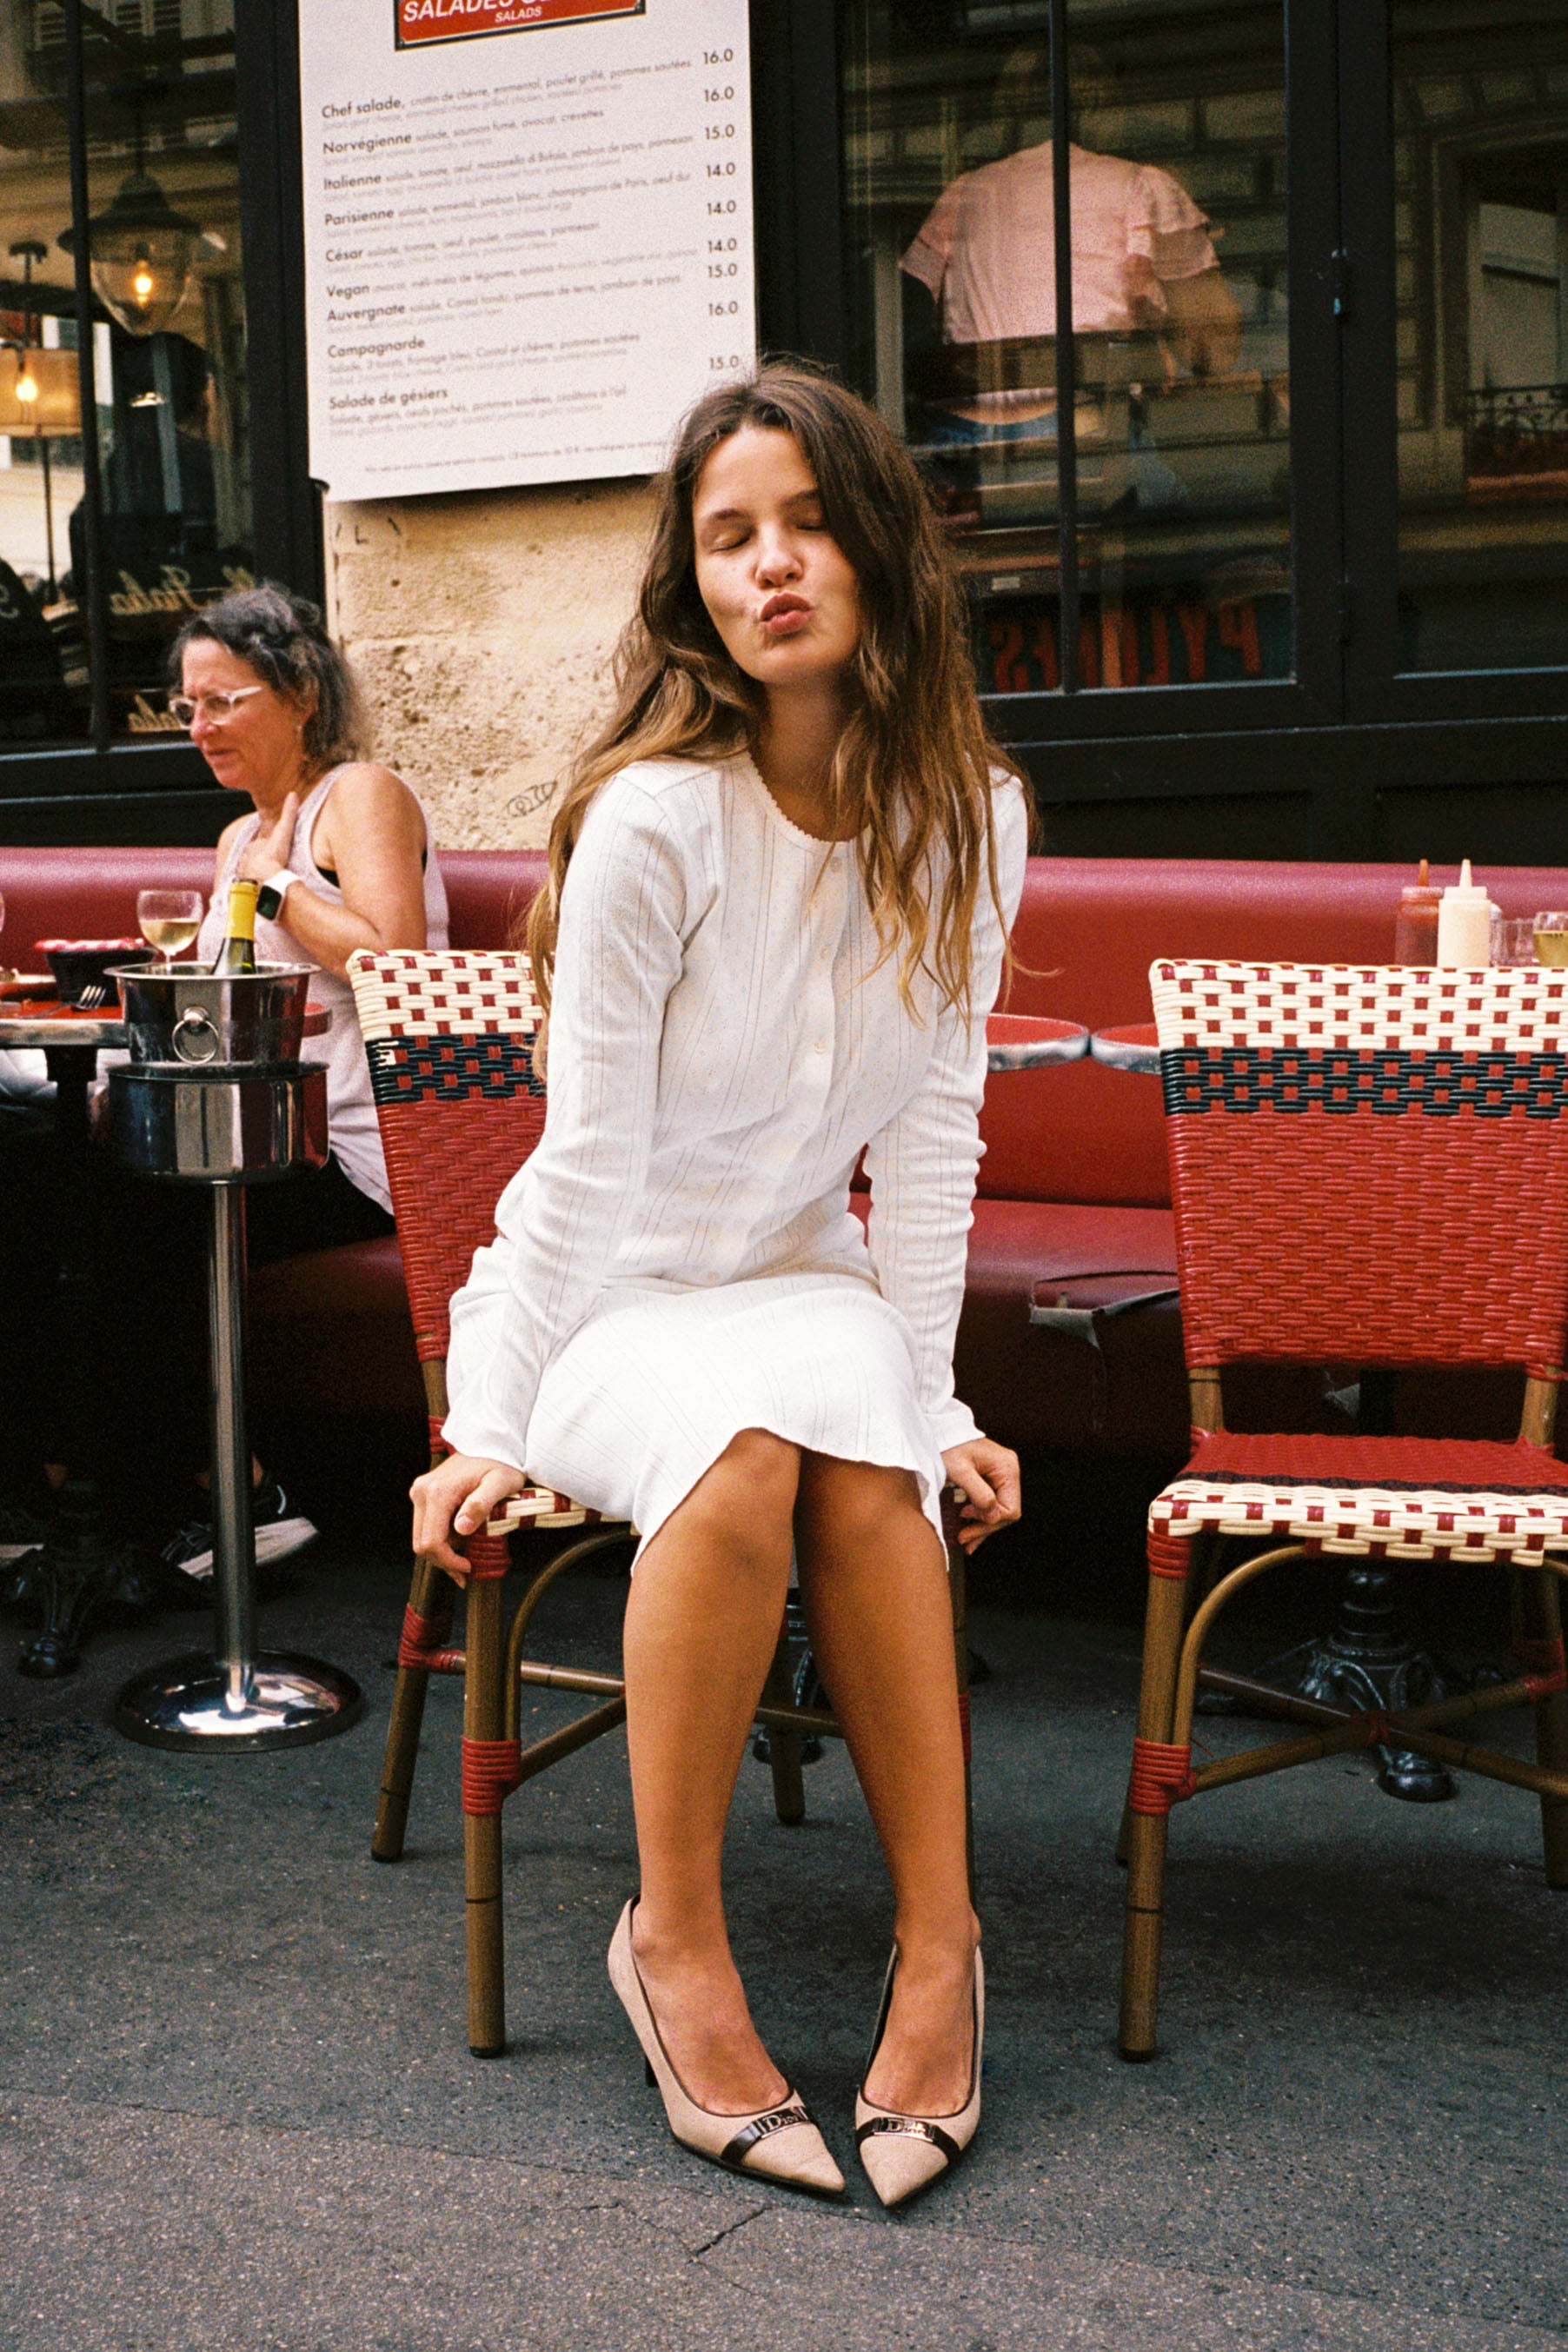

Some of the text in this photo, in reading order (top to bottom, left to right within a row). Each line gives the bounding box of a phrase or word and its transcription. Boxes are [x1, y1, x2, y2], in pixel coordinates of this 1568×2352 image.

[495, 7, 541, 23] SALADS
[321, 103, 351, 118] Chef
[356, 96, 404, 115] salade,
[441, 90, 454, 101] de
[702, 49, 733, 65] 16.0
[322, 131, 411, 155] Norvégienne
[703, 87, 734, 103] 16.0
[323, 172, 381, 189] Italienne
[704, 125, 734, 141] 15.0
[324, 207, 394, 226] Parisienne
[705, 163, 735, 178] 14.0
[325, 247, 362, 262] César
[706, 201, 735, 216] 14.0
[326, 282, 369, 301] Vegan
[707, 239, 736, 254] 14.0
[327, 302, 405, 323] Auvergnate
[707, 264, 736, 279] 15.0
[328, 302, 738, 360] Campagnarde 16.0
[329, 355, 739, 409] Salade de gésiers 15.0
[765, 2113, 801, 2131] Dior
